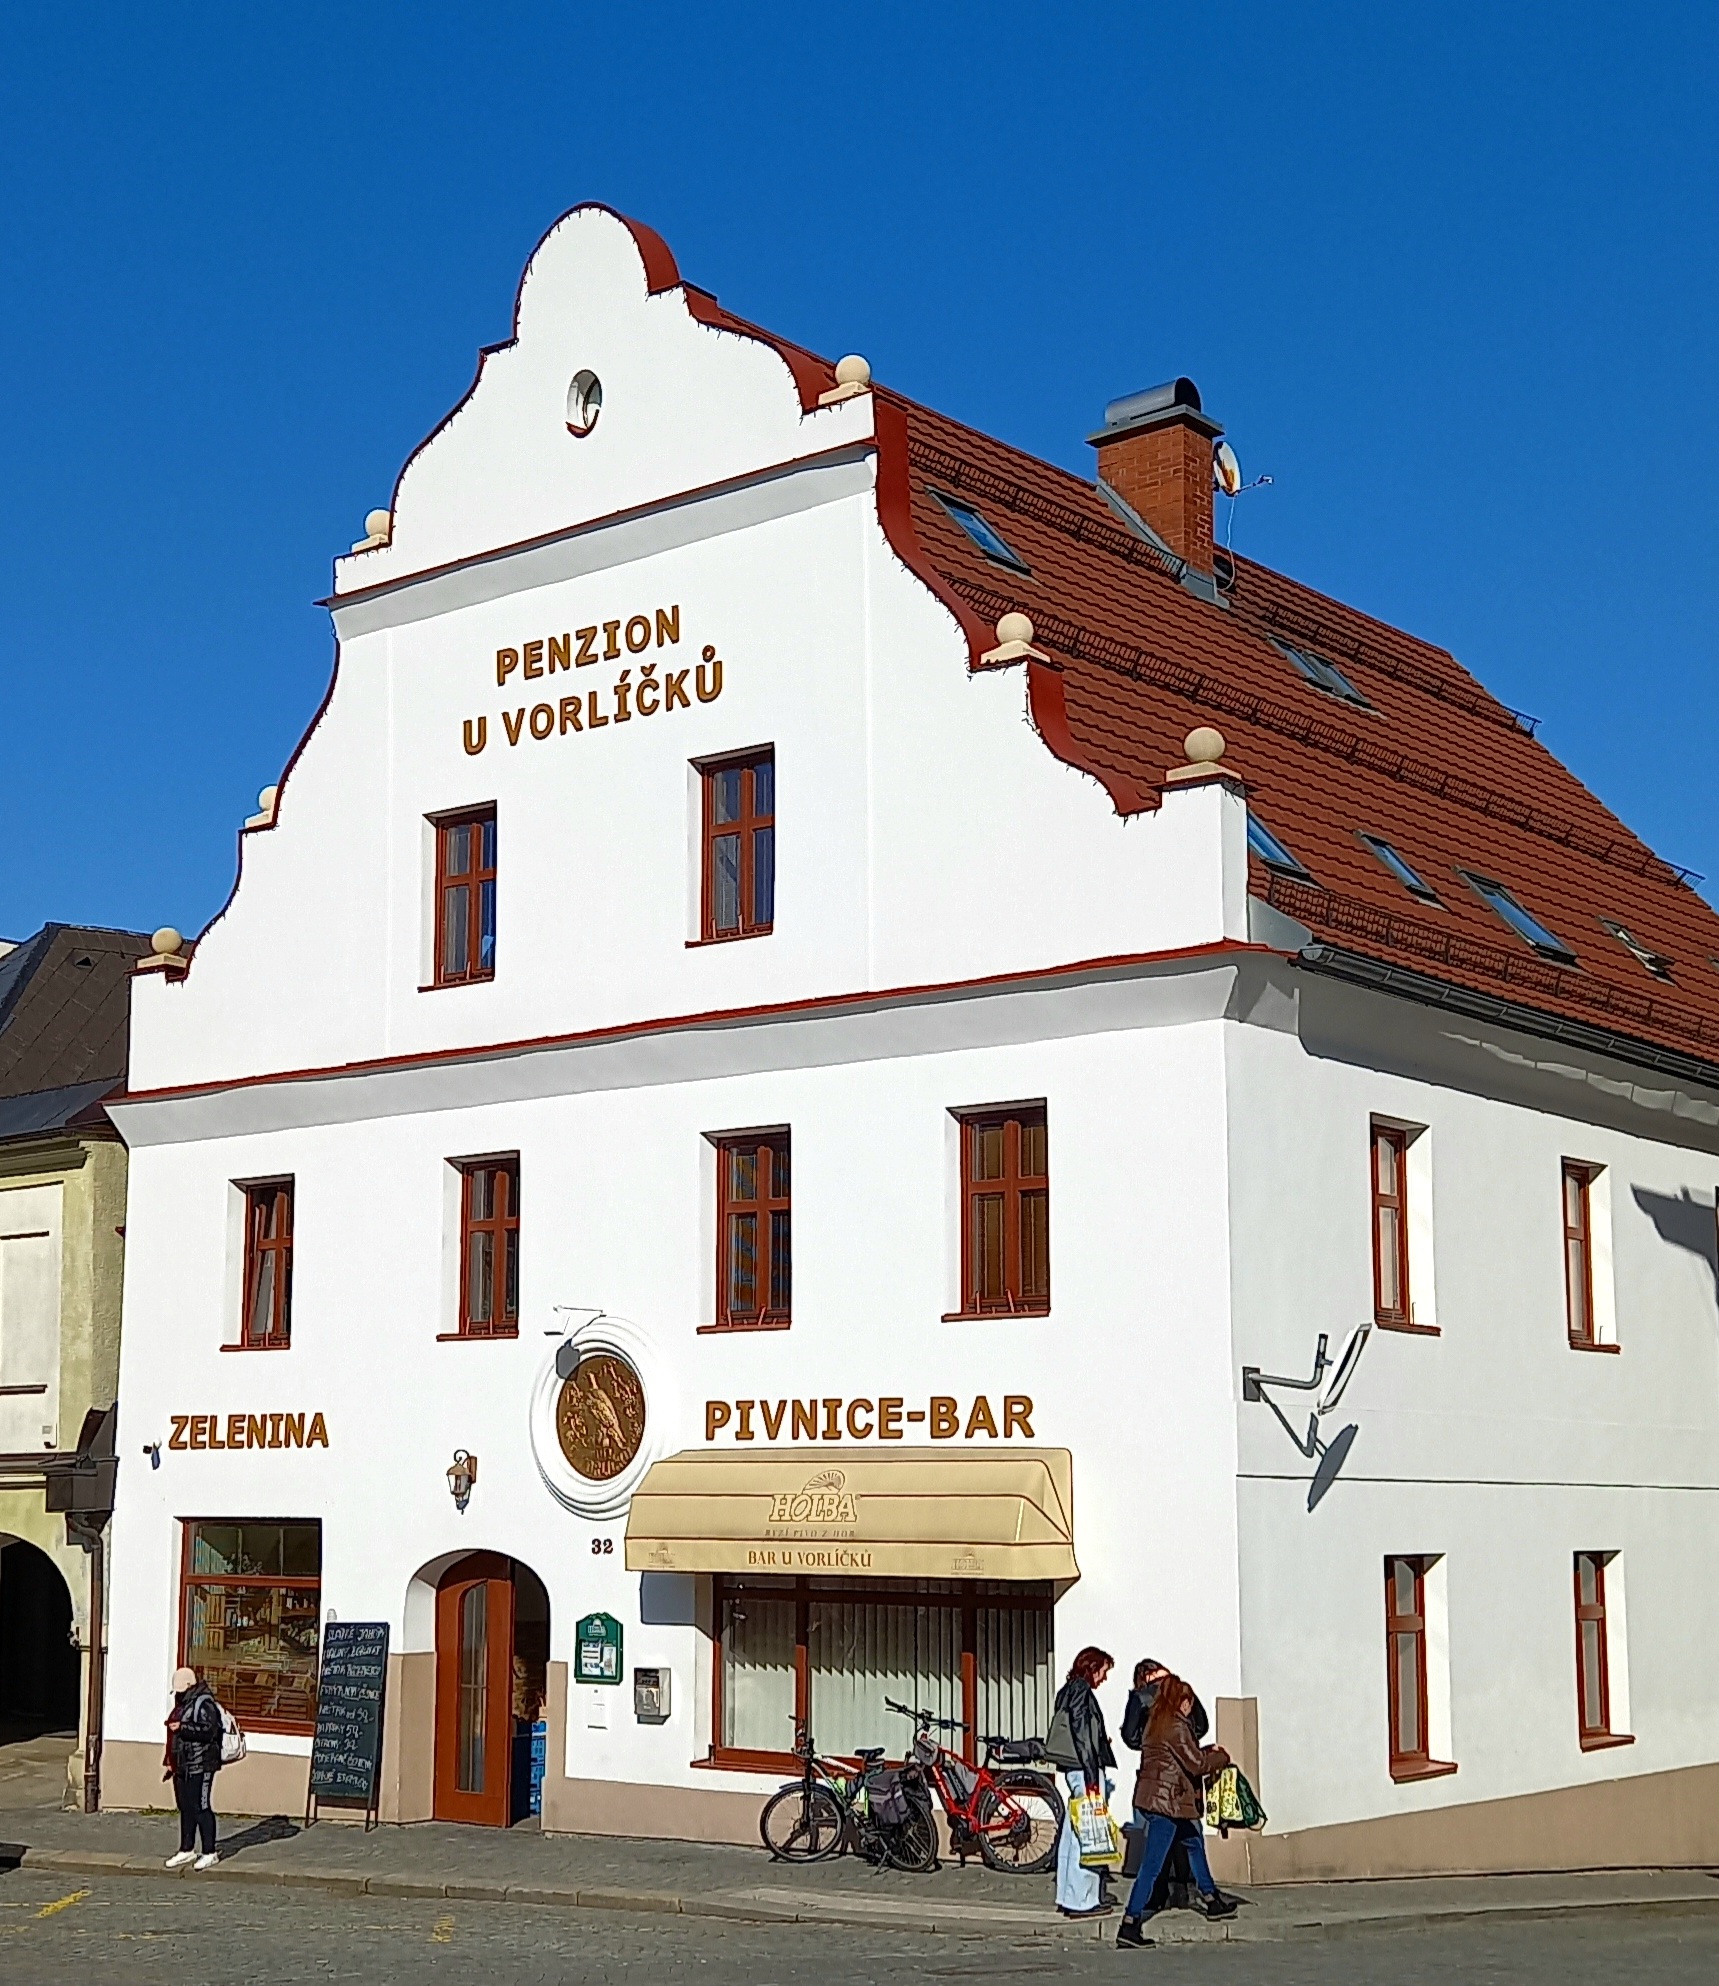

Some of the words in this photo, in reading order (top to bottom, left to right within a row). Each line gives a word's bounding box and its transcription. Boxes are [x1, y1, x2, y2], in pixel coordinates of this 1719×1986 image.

[496, 604, 680, 687] PENZION
[463, 716, 487, 756] U
[501, 645, 723, 747] VORLÍČKŮ
[168, 1412, 329, 1450] ZELENINA
[704, 1395, 1036, 1441] PIVNICE-BAR
[769, 1493, 858, 1522] HOLBA
[591, 1538, 614, 1555] 32
[748, 1550, 776, 1565] BAR
[782, 1550, 792, 1565] U
[797, 1548, 872, 1567] VORLÍČKŮ
